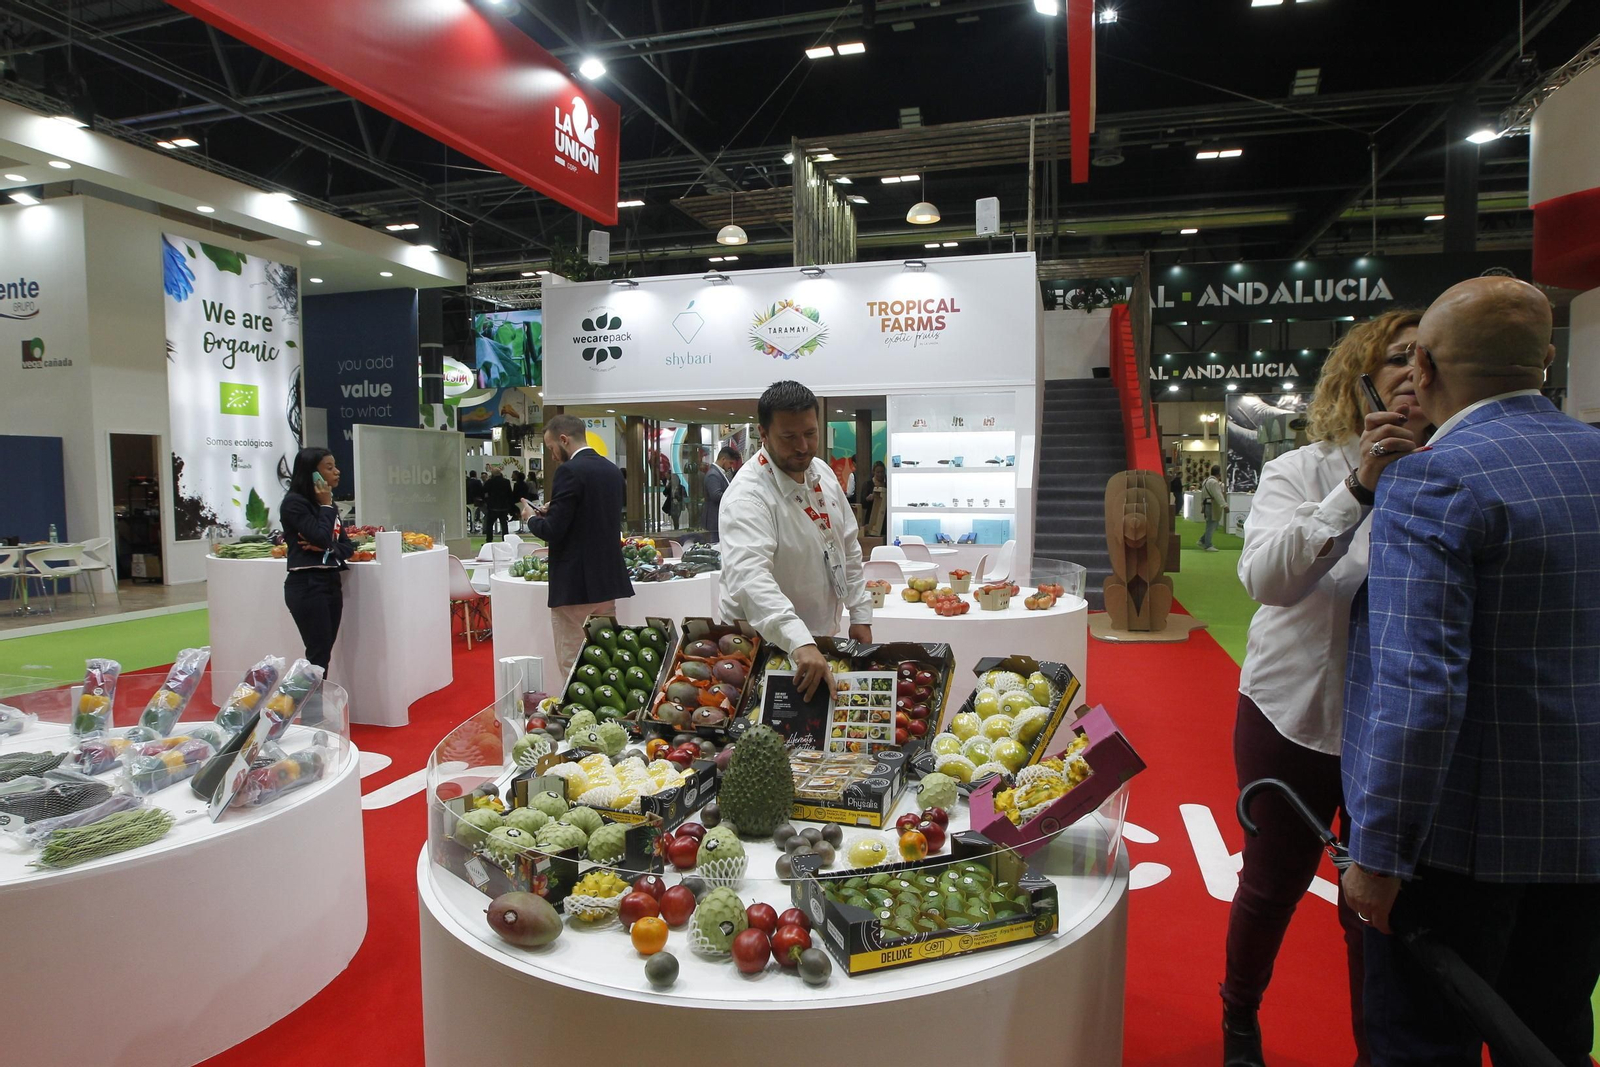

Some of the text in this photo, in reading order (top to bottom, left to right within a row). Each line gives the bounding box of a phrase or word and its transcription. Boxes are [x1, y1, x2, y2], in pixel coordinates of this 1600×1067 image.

[555, 105, 573, 137] LA
[555, 128, 599, 175] UNION
[1197, 277, 1394, 307] ANDALUCIA
[13, 301, 35, 312] GRUPO
[867, 297, 961, 317] TROPICAL
[202, 299, 273, 333] We are
[881, 315, 946, 333] FARMS
[573, 332, 632, 344] wecarepack
[338, 355, 394, 374] you add
[665, 352, 712, 369] shybari
[1182, 363, 1300, 380] ANDALUCIA
[341, 380, 393, 398] value
[340, 404, 392, 418] to what
[206, 437, 273, 448] Somos ecológicos
[387, 465, 437, 485] Hello!
[847, 796, 879, 810] Physalis
[881, 948, 913, 964] DELUXE
